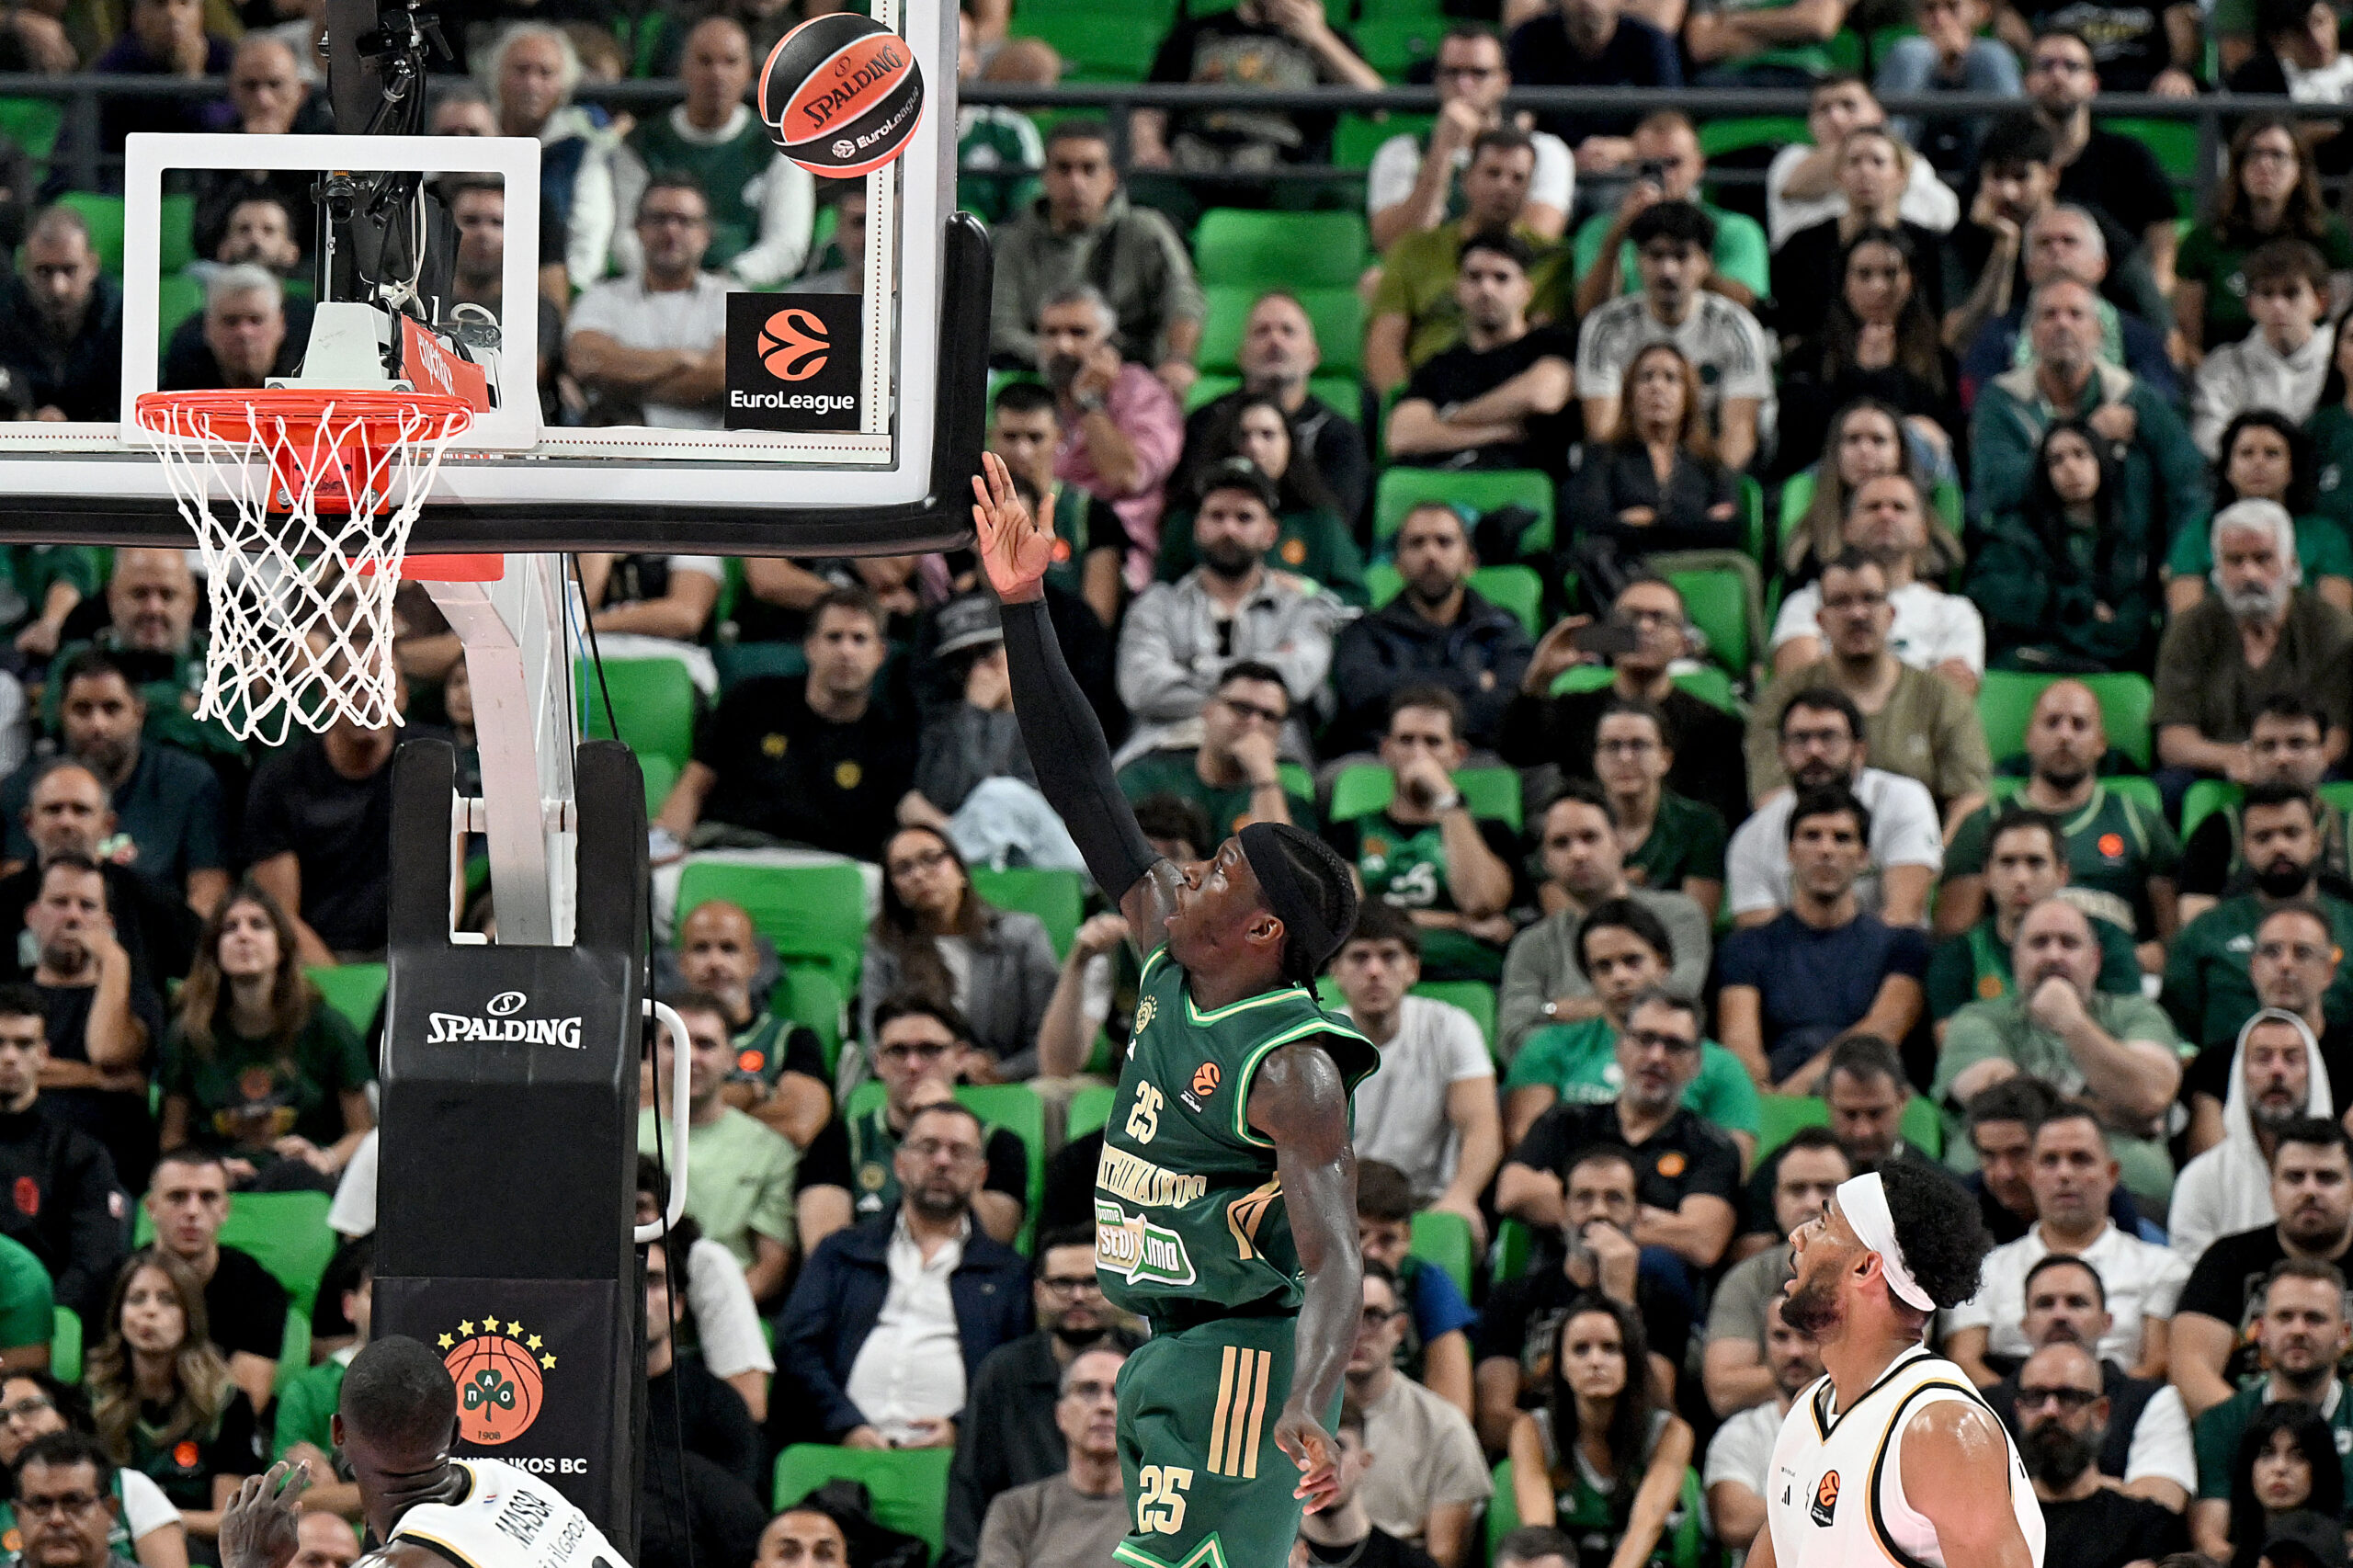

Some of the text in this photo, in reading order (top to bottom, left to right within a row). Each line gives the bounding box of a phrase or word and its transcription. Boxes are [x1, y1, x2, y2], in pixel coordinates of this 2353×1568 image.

[803, 44, 904, 130] SPALDING
[857, 86, 919, 150] EuroLeague
[730, 390, 855, 415] EuroLeague
[426, 1012, 583, 1050] SPALDING
[1125, 1079, 1165, 1145] 25
[477, 1430, 502, 1441] 1908
[560, 1458, 588, 1474] BC
[494, 1489, 555, 1551] MASSA
[1137, 1464, 1194, 1536] 25
